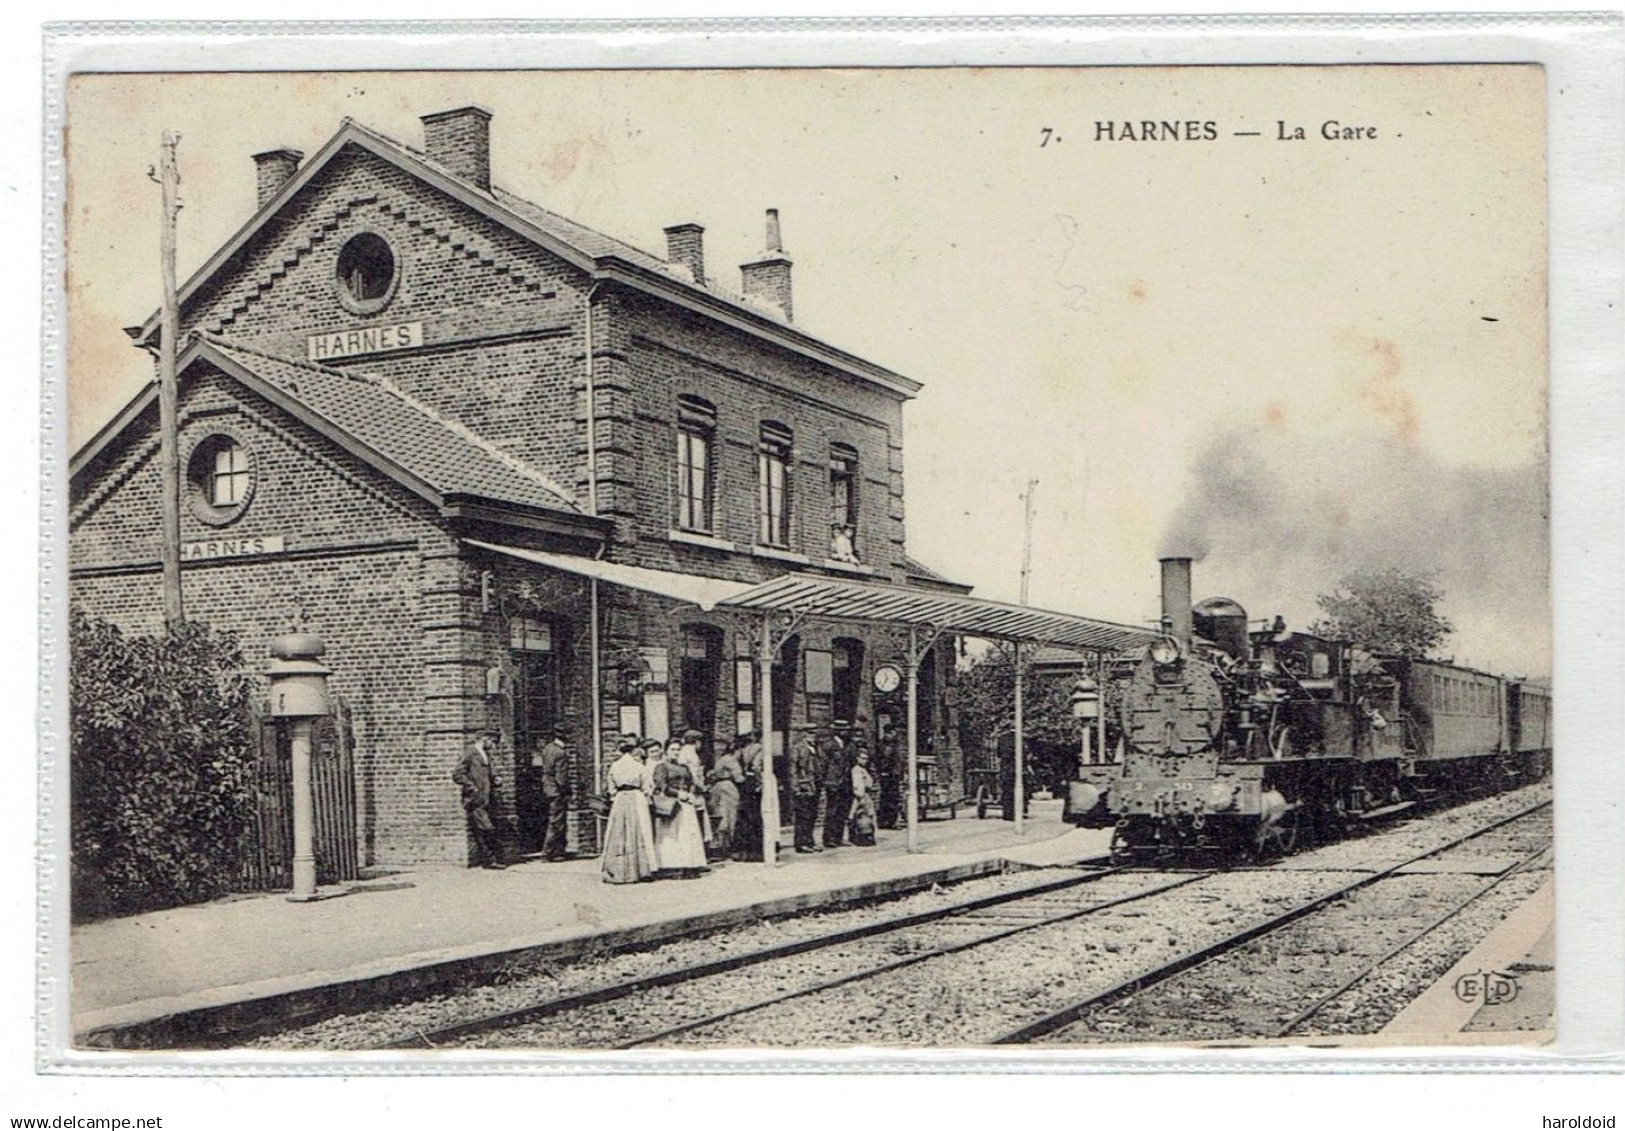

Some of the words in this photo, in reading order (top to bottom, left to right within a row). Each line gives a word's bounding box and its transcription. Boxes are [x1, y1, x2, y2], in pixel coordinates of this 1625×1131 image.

[1040, 127, 1063, 148] 7.
[1093, 120, 1219, 142] HARNES
[1276, 120, 1306, 141] La
[1320, 119, 1378, 141] Gare
[314, 325, 412, 358] HARNES
